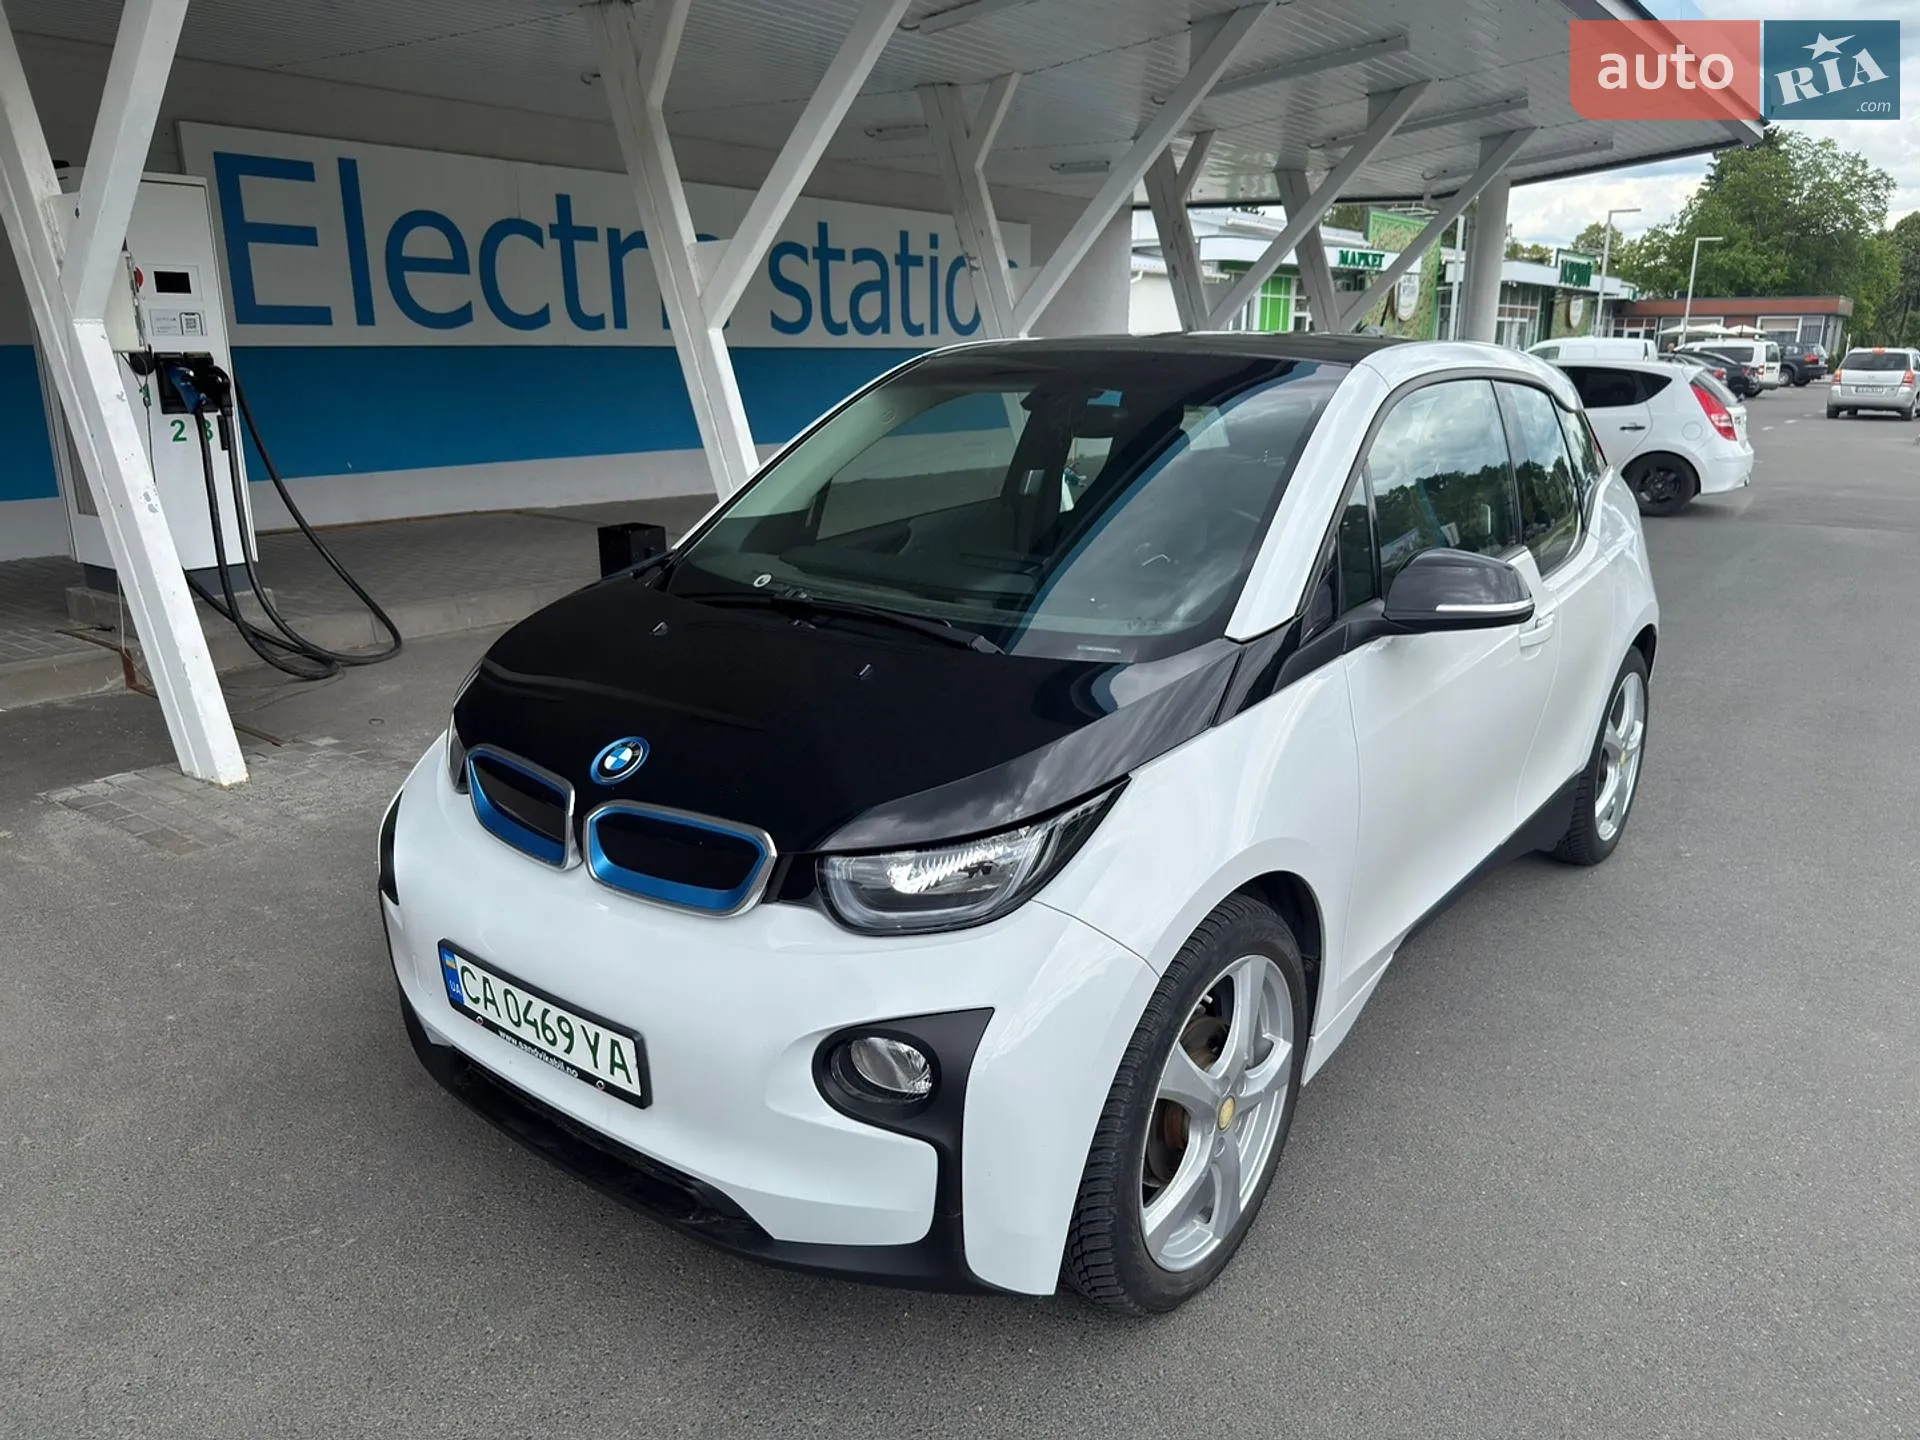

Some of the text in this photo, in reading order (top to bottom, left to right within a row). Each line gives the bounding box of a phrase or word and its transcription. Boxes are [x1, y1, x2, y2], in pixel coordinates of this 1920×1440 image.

[214, 152, 1018, 336] Electr statio
[170, 420, 187, 442] 2
[450, 979, 461, 994] UA
